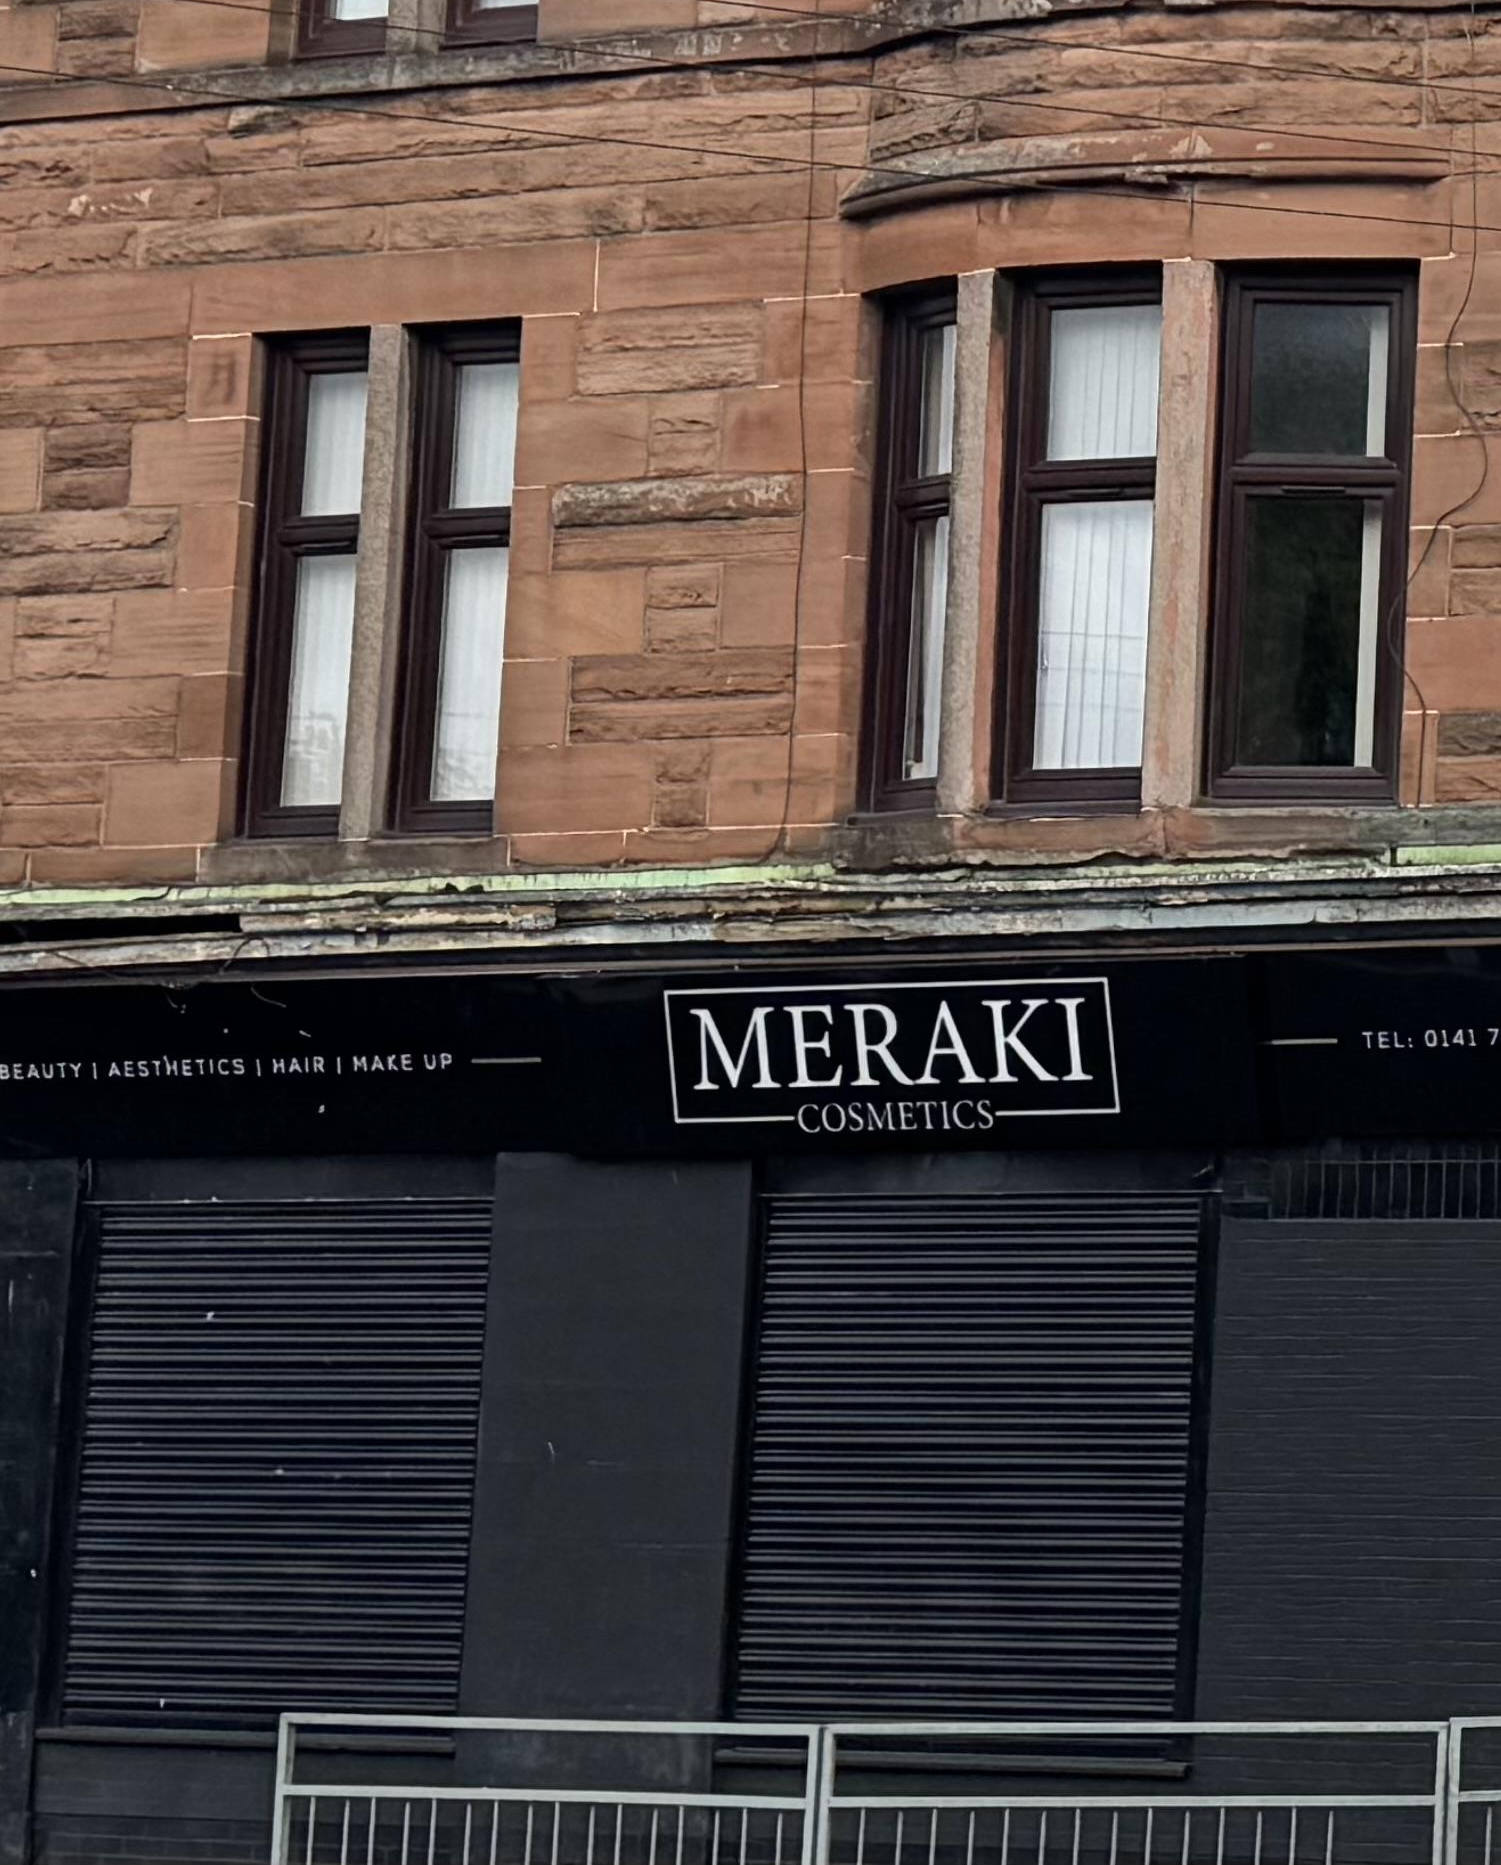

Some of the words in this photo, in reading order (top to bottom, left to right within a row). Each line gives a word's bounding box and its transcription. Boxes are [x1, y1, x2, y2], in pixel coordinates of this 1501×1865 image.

[690, 998, 1093, 1089] MERAKI
[1362, 1031, 1413, 1049] TEL:
[1424, 1028, 1477, 1048] 0141
[0, 1062, 82, 1080] BEAUTY
[108, 1057, 245, 1077] AESTHETICS
[272, 1056, 325, 1074] HAIR
[352, 1053, 413, 1072] MAKE
[423, 1052, 453, 1070] UP
[798, 1100, 993, 1132] COSMETICS
